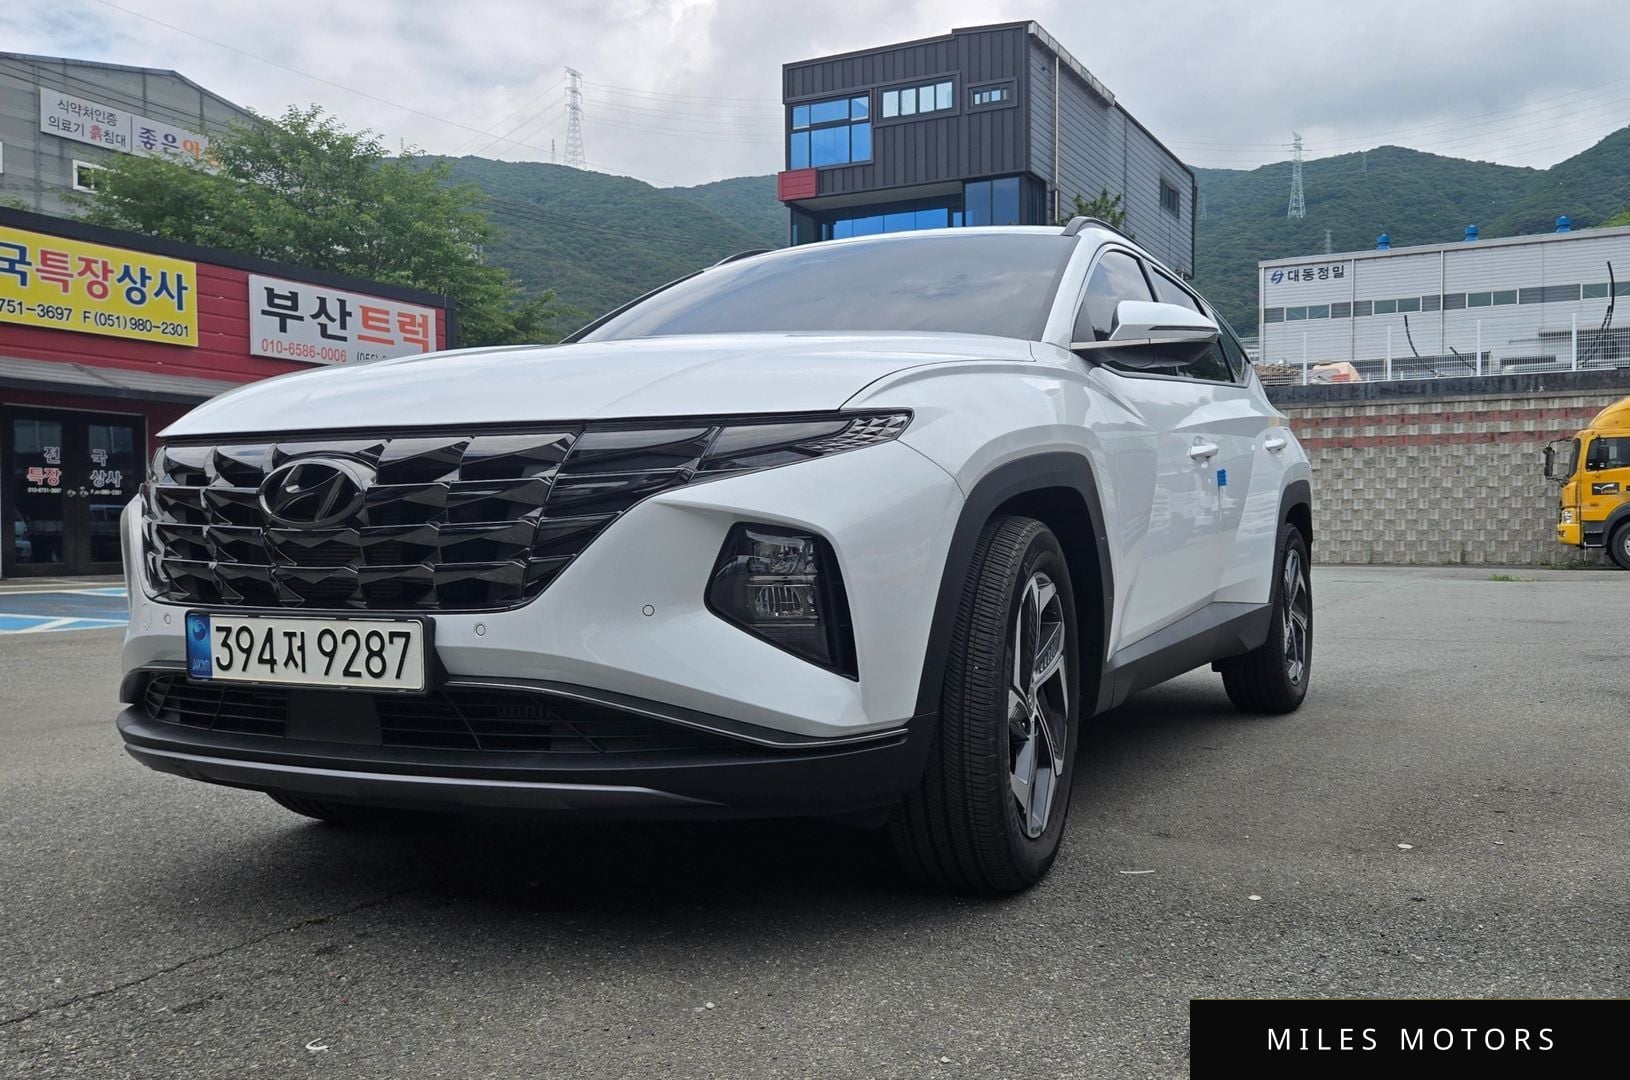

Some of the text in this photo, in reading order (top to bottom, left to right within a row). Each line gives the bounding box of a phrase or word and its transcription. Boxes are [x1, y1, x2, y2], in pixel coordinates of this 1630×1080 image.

[57, 99, 118, 127] 식약처인증
[48, 115, 126, 147] 의료기 흙침대
[0, 242, 189, 311] 국특장상사
[1287, 265, 1345, 282] 대동정밀
[261, 286, 430, 353] 부산트럭
[262, 339, 347, 362] 010-6586-0006
[91, 448, 108, 467] 국
[26, 467, 123, 488] 특장 상사
[215, 625, 412, 679] 394저 9287
